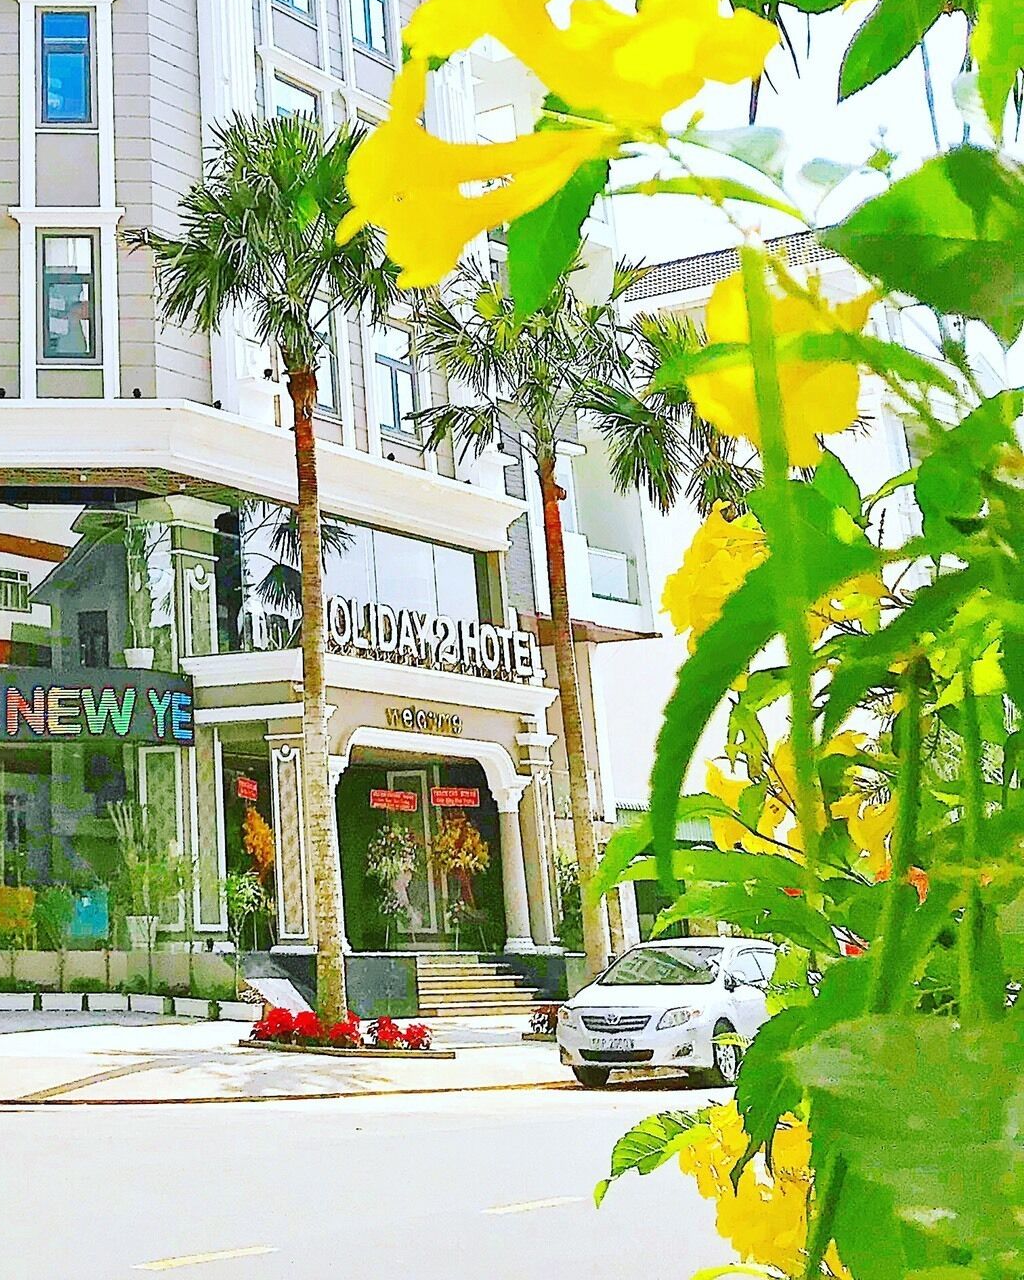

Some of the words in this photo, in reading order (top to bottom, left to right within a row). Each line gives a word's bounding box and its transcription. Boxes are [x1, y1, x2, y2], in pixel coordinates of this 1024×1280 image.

[458, 617, 547, 679] HOTEL
[5, 685, 137, 737] NEW
[148, 687, 194, 740] YE
